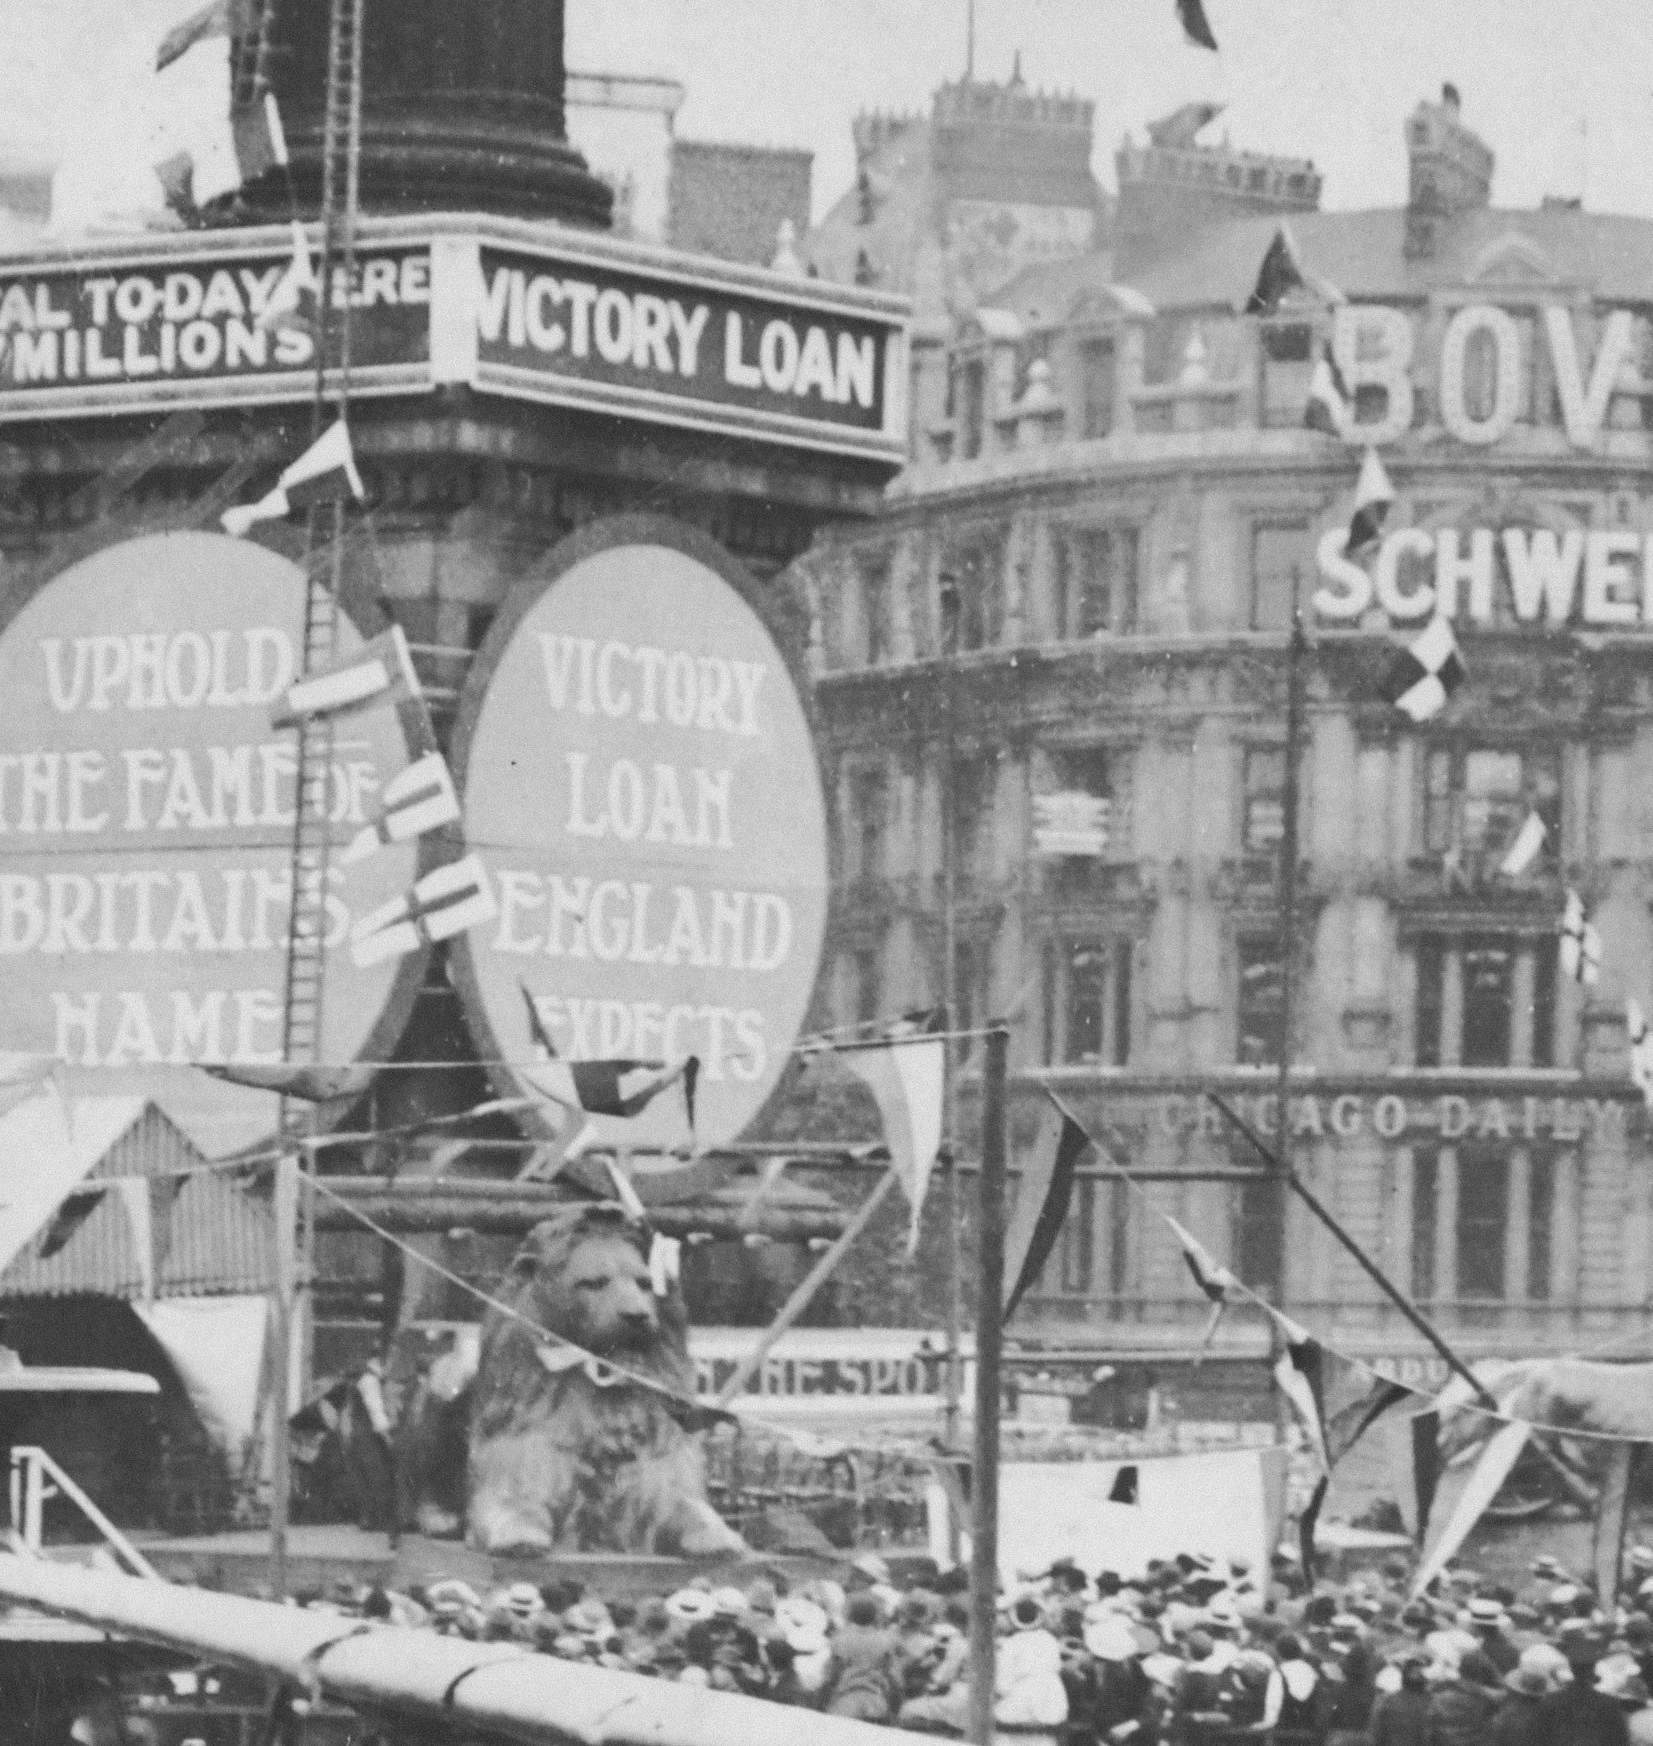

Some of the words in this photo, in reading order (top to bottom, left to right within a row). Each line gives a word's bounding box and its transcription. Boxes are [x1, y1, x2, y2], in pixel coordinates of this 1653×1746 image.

[12, 318, 315, 382] MILLIONS
[474, 262, 708, 375] VICTORY
[726, 310, 876, 408] LOAN
[40, 627, 293, 712] UPHOLD
[538, 632, 766, 736] VICTORY
[119, 743, 303, 830] FAME
[564, 750, 734, 849] LOAN
[491, 867, 793, 972] ENGLAND
[1157, 1092, 1409, 1139] CHICAGO
